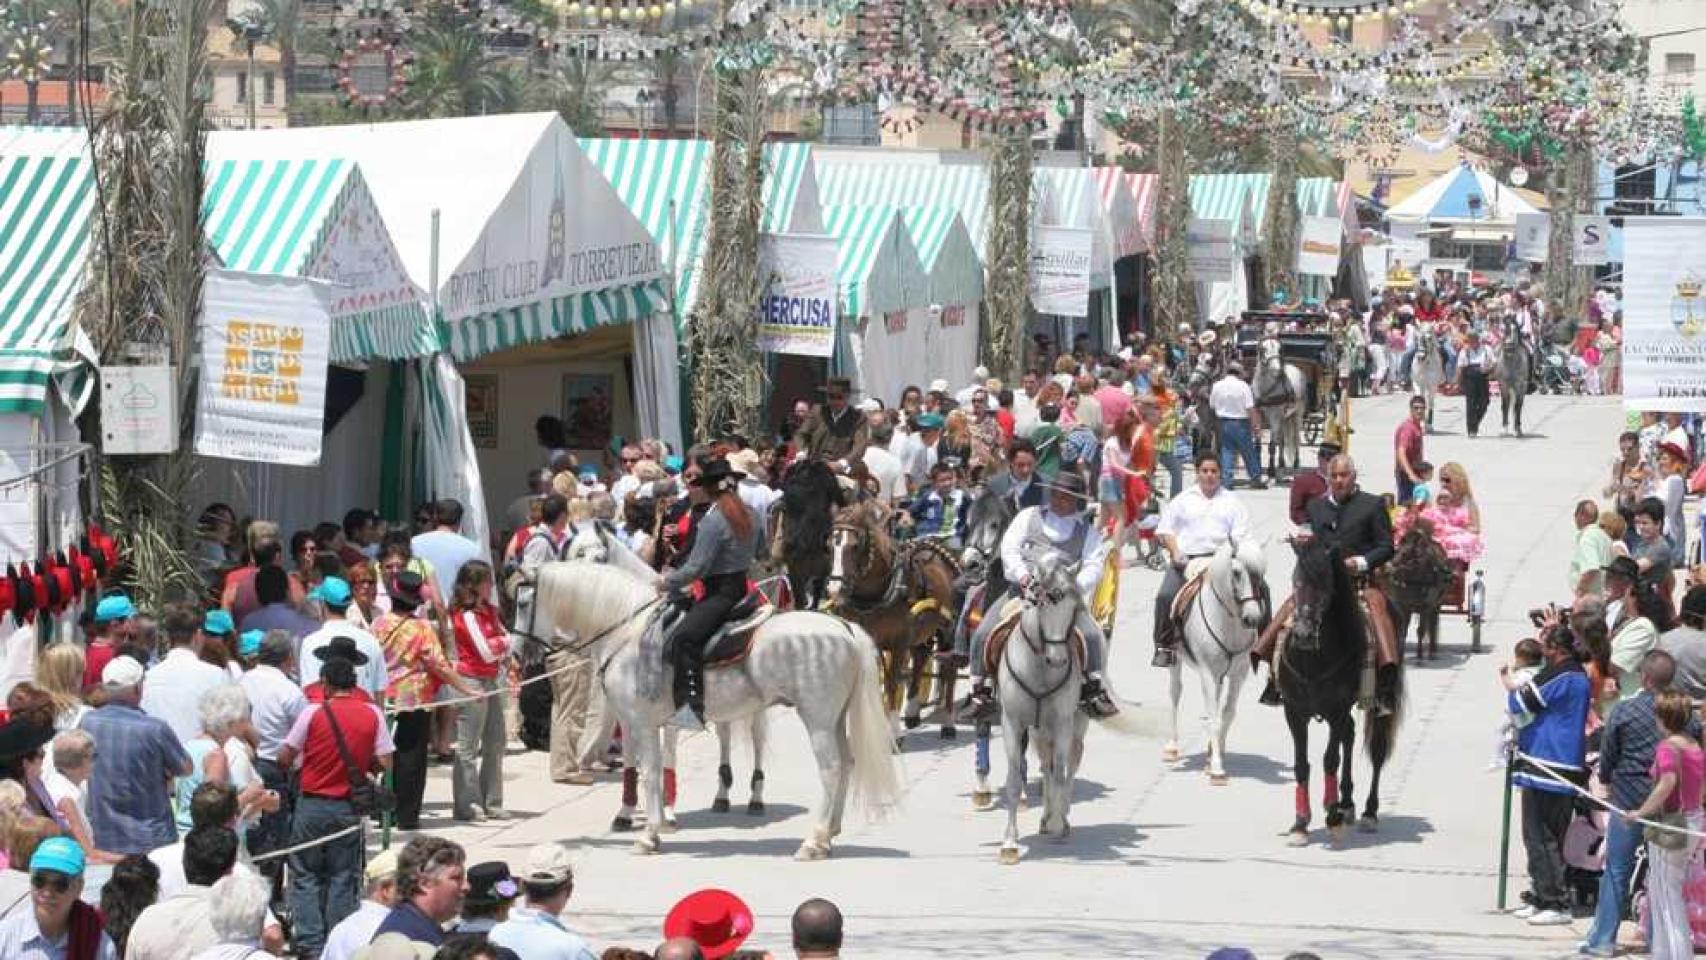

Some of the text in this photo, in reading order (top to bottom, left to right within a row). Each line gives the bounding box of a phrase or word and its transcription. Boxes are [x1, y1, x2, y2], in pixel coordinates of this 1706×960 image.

[1583, 224, 1600, 245] S
[502, 260, 539, 300] CLUB
[568, 240, 658, 288] TORREVIEJA
[759, 296, 831, 328] HERCUSA
